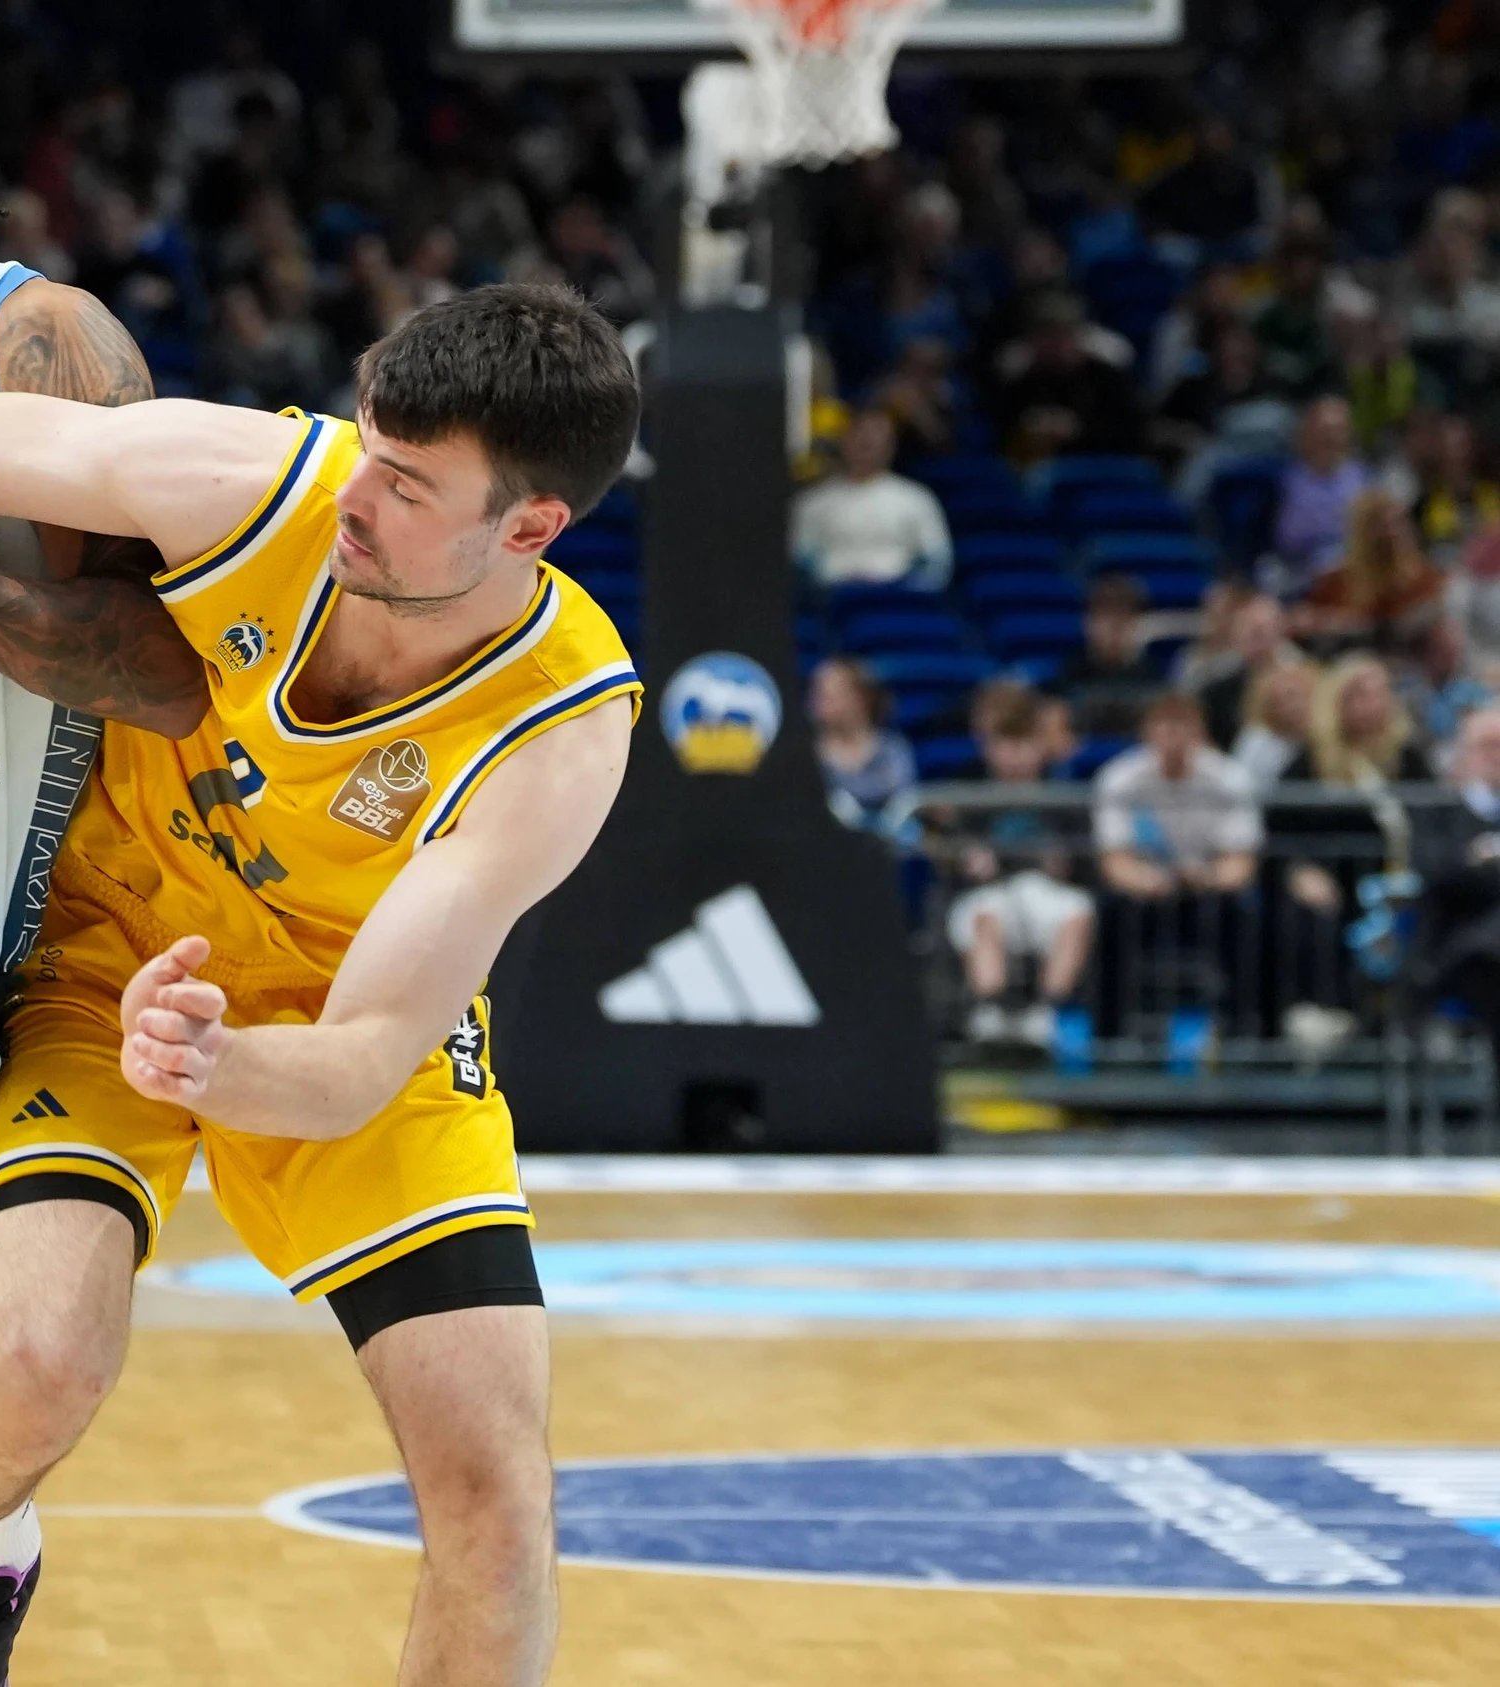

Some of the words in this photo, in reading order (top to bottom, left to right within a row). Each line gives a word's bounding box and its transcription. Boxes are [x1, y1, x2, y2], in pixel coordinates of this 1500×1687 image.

[219, 638, 247, 670] ALBA
[356, 777, 390, 803] easy
[338, 797, 393, 836] BBL
[365, 795, 405, 820] Credit
